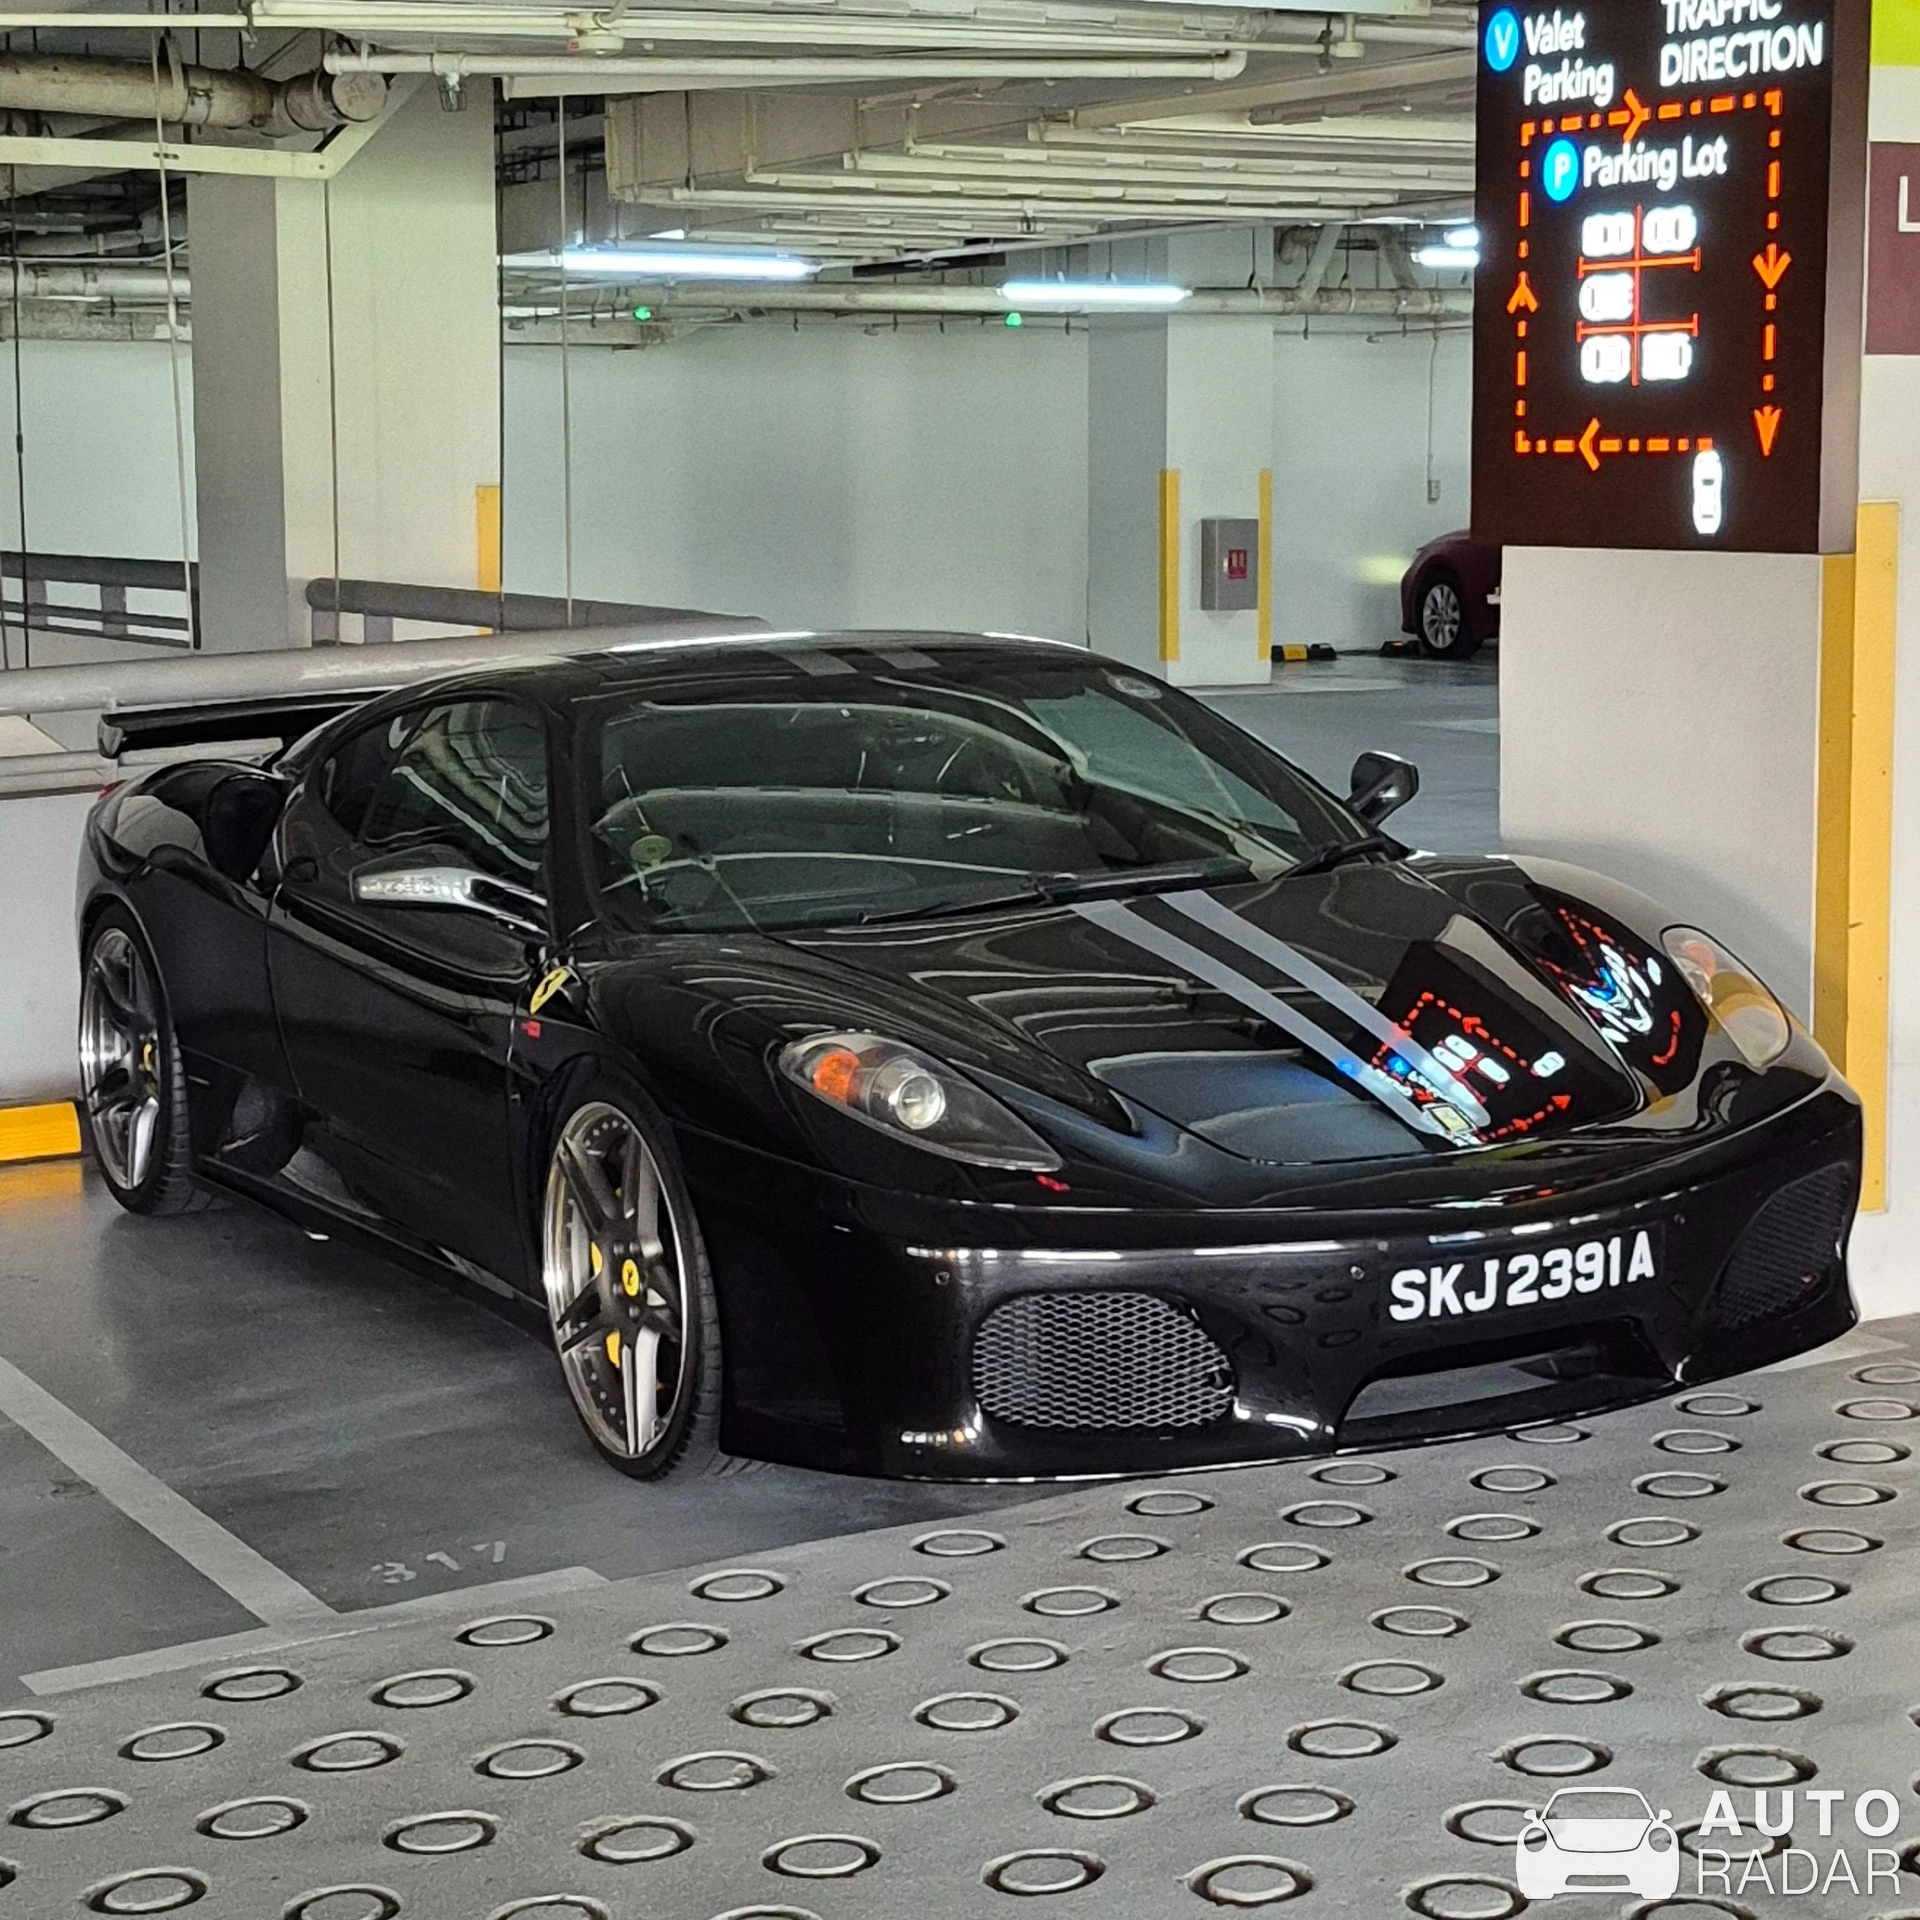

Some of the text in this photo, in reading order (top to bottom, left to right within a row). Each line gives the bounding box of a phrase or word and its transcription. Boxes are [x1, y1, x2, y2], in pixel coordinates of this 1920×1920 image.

[1523, 8, 1585, 56] Valet
[1659, 20, 1824, 87] DIRECTION
[1523, 57, 1615, 107] Parking
[1583, 139, 1678, 191] Parking
[1682, 134, 1729, 178] Lot
